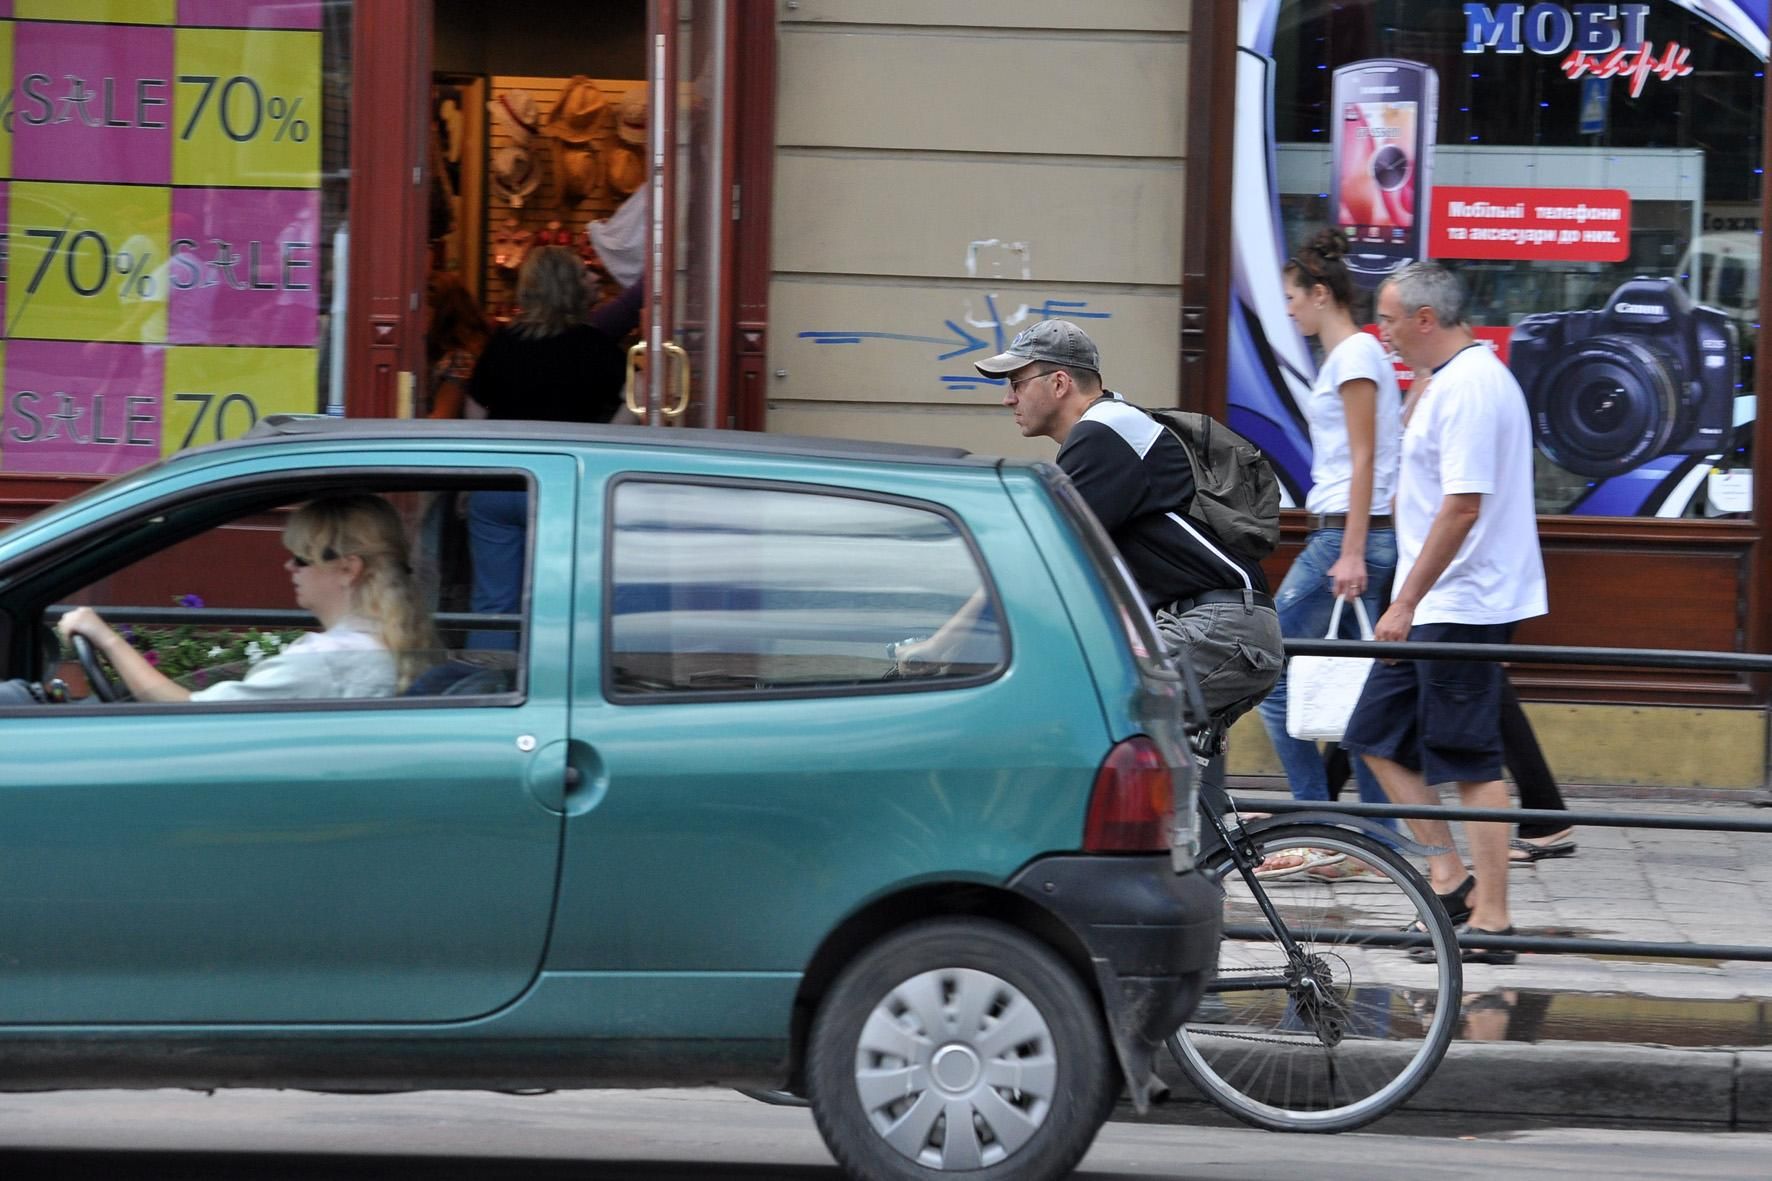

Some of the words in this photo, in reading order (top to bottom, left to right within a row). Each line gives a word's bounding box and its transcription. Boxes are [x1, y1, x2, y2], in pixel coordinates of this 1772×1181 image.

[21, 74, 167, 129] SALE
[177, 75, 310, 143] 70%
[22, 230, 156, 298] 70%
[169, 239, 313, 291] SALE
[1615, 302, 1665, 315] Canon
[9, 391, 156, 447] SALE
